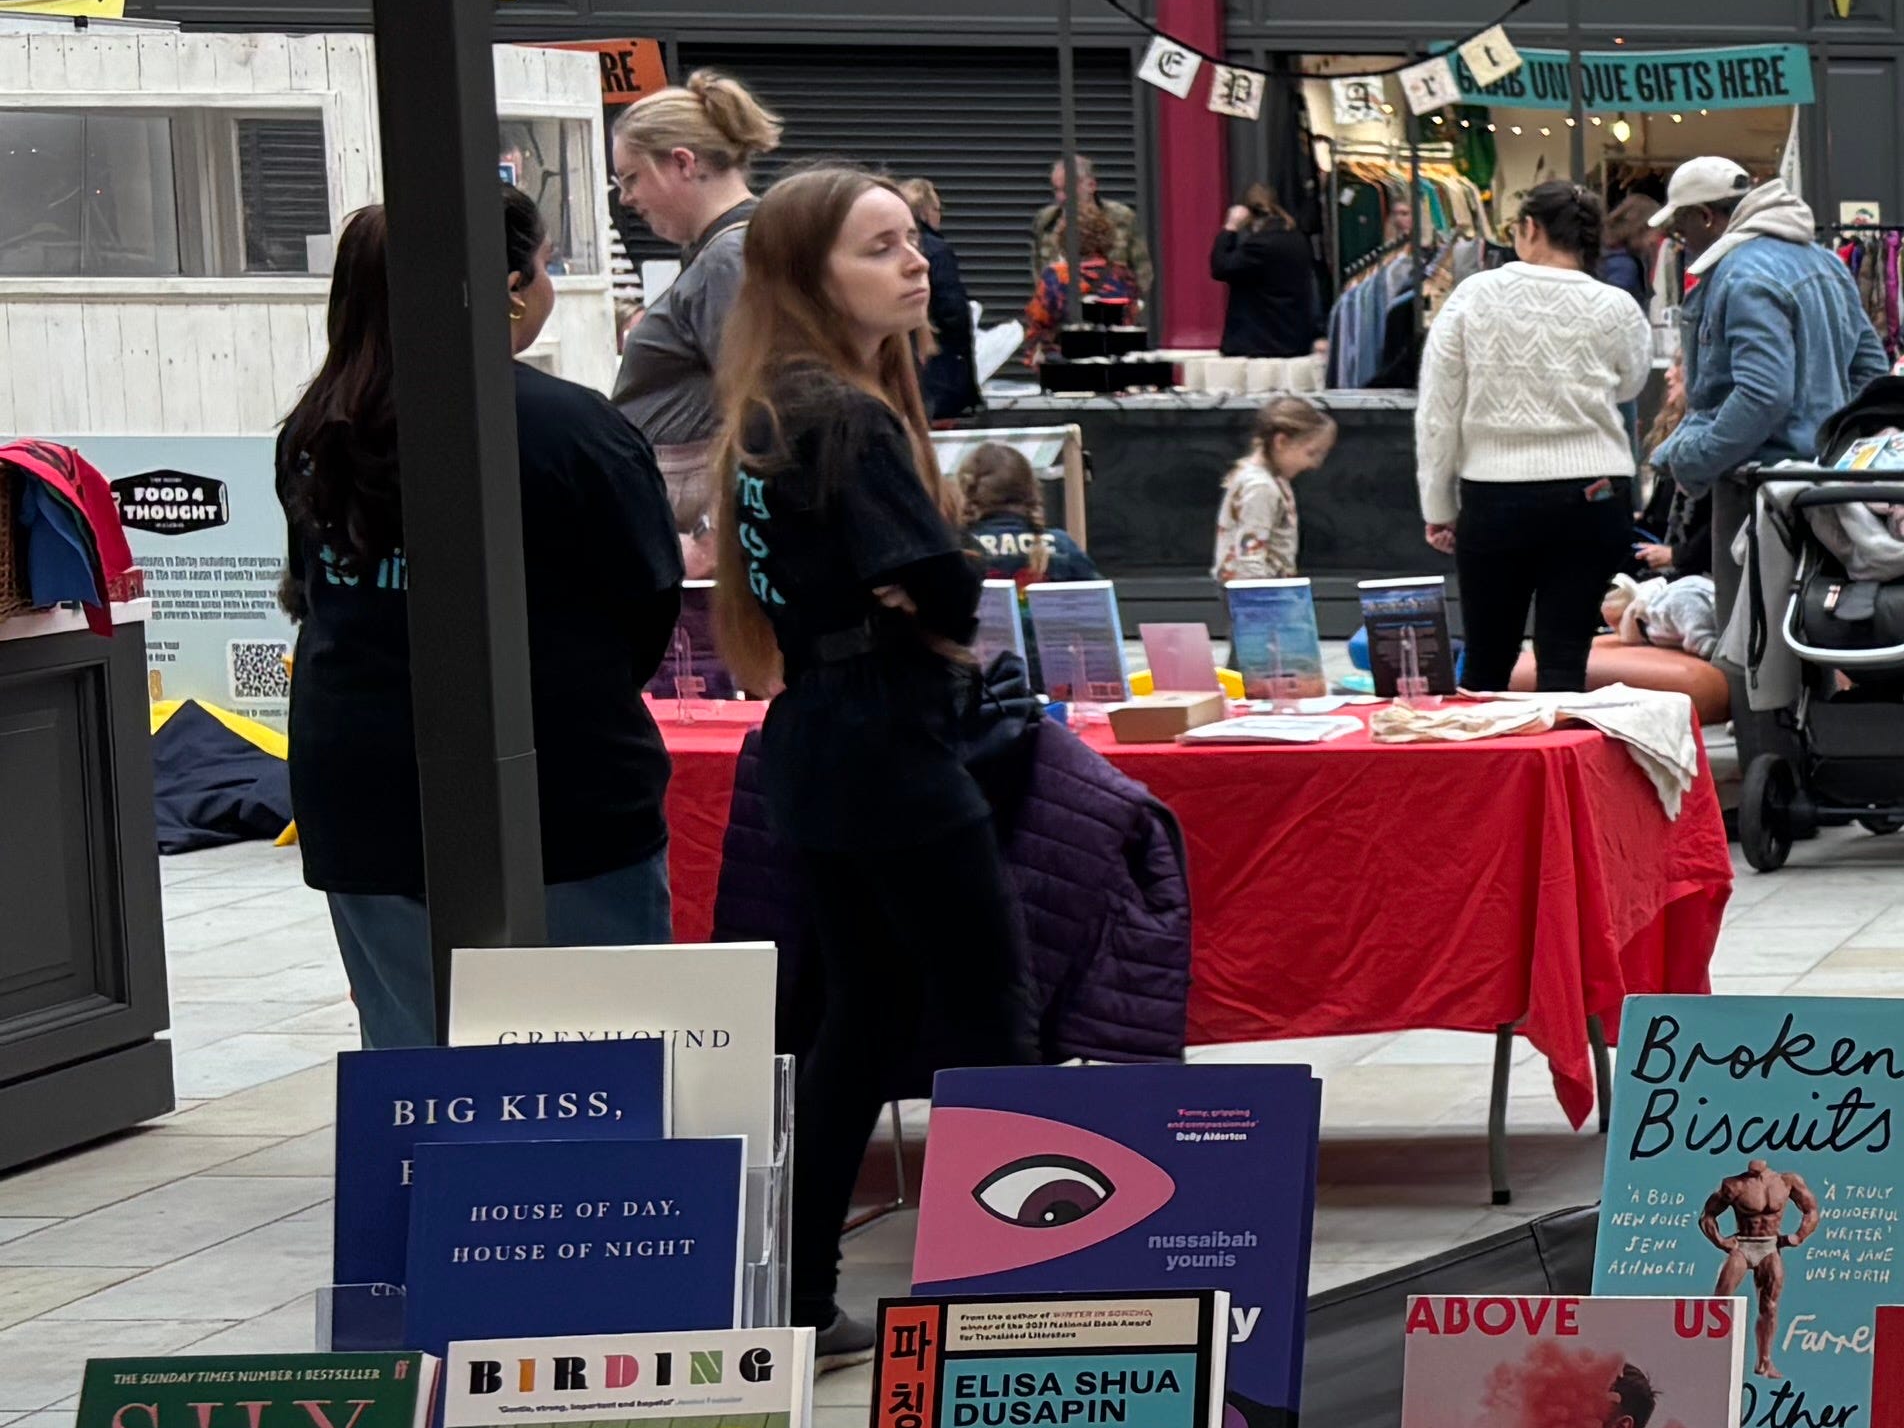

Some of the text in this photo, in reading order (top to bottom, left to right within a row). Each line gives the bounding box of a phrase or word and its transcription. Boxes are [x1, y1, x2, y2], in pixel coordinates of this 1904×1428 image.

[1531, 60, 1632, 103] UNQUE
[1636, 60, 1714, 101] GIFTS
[1716, 56, 1789, 98] HERE
[134, 487, 204, 502] FOOD 4
[124, 505, 217, 520] THOUGHT
[1631, 1014, 1904, 1083] Broken
[393, 1091, 622, 1126] BIG KISS,
[1630, 1088, 1891, 1159] Biscuits
[471, 1203, 563, 1222] HOUSE
[576, 1202, 611, 1218] OF
[453, 1239, 695, 1262] HOUSE OF NIGHT
[1148, 1230, 1258, 1250] nussaibah
[1625, 1236, 1677, 1253] JENN
[1167, 1251, 1236, 1270] younis
[1806, 1248, 1893, 1262] EMMA JANE
[1806, 1268, 1890, 1283] UNSWORTH
[1405, 1297, 1732, 1339] ABOVE US
[114, 1374, 138, 1384] THE
[141, 1373, 195, 1384] SUNDAY
[198, 1372, 235, 1383] TIMES
[238, 1371, 293, 1382] NUMBER
[305, 1369, 380, 1380] BESTSELLER
[469, 1348, 774, 1394] BIRDING
[955, 1370, 1179, 1399] ELISA SHUA
[954, 1399, 1125, 1427] DUSAPIN
